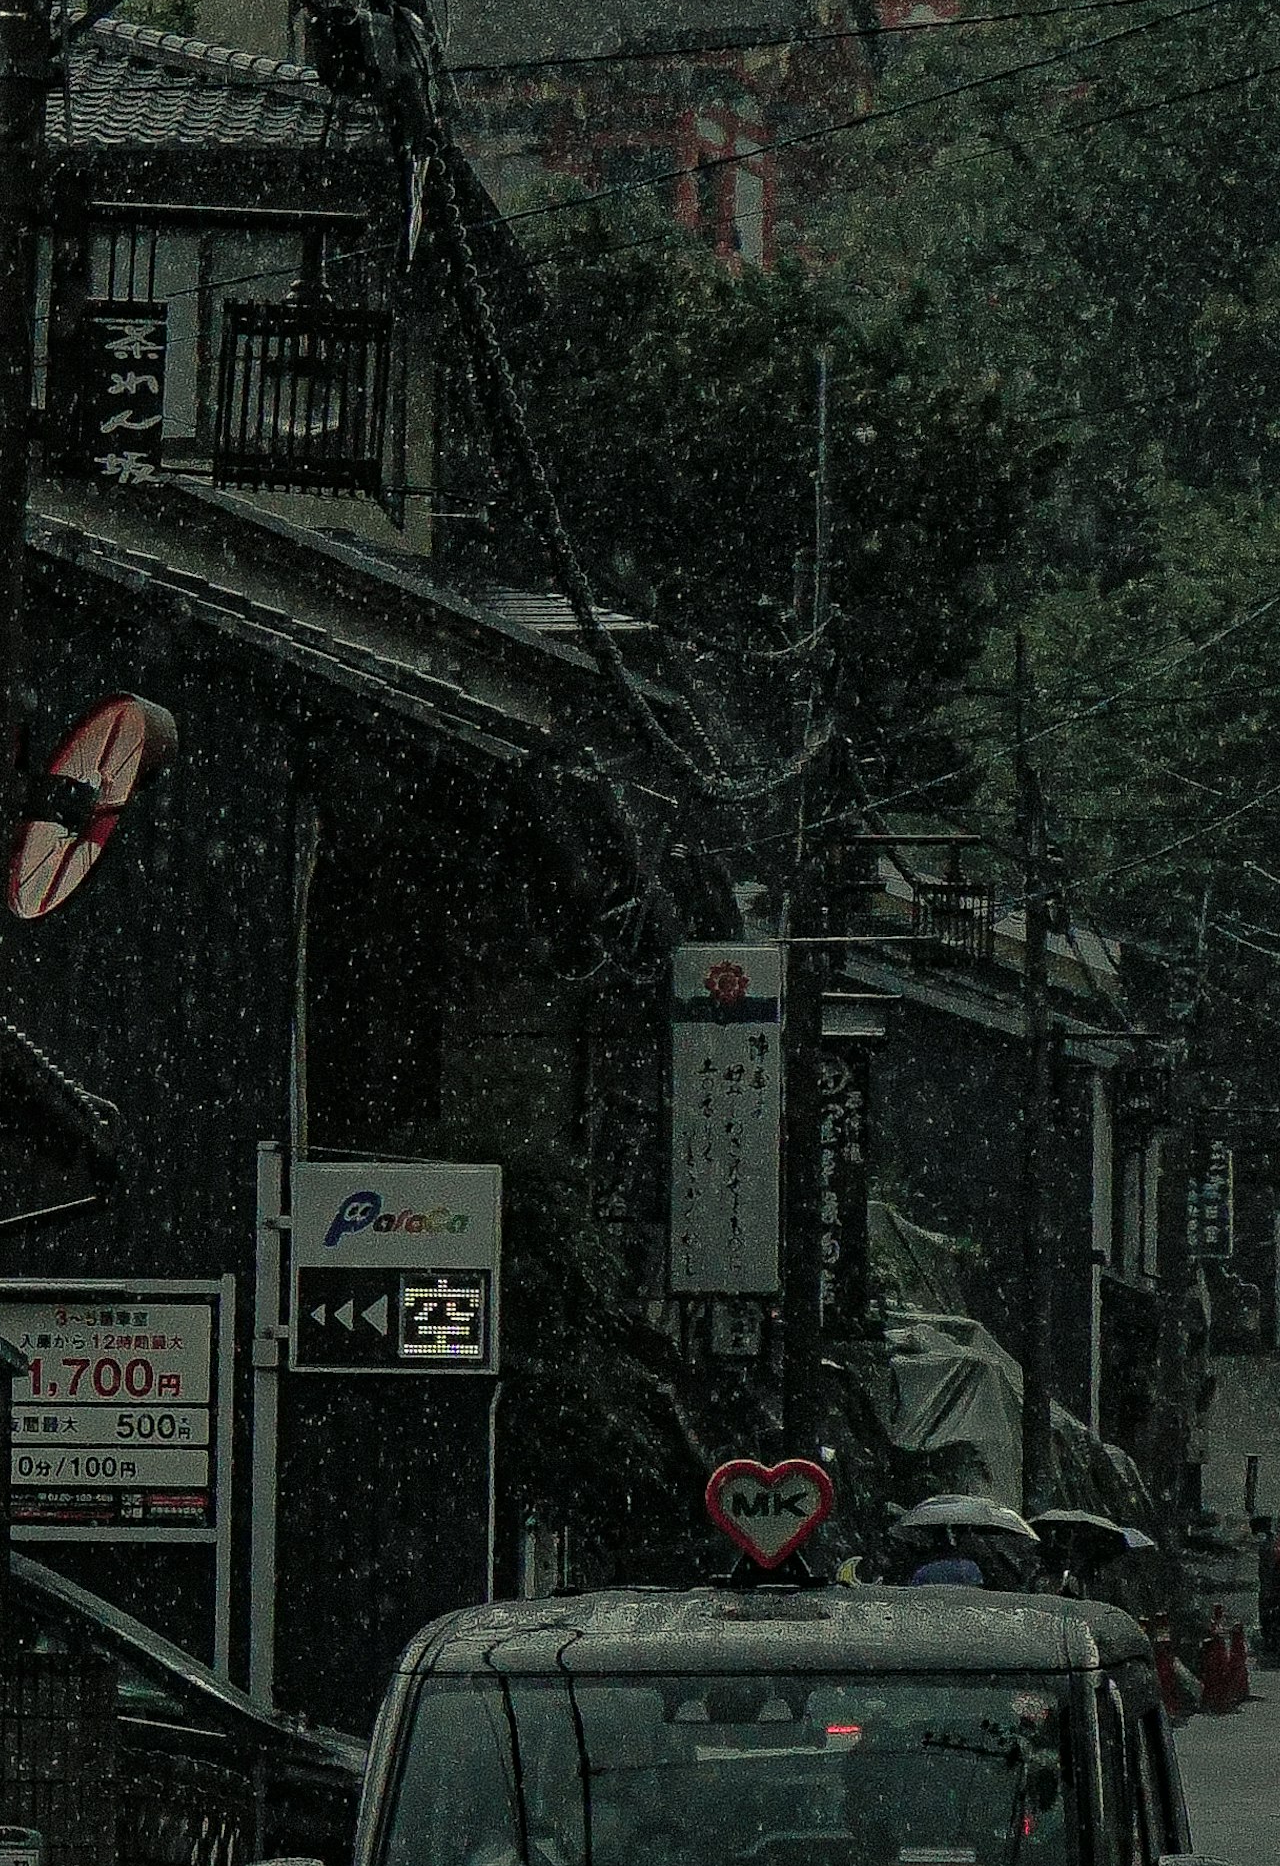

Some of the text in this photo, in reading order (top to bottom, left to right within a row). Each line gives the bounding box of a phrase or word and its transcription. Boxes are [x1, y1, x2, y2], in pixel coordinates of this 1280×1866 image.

[403, 1279, 481, 1355] 空
[27, 1357, 181, 1397] 1,700円
[732, 1492, 808, 1517] MK
